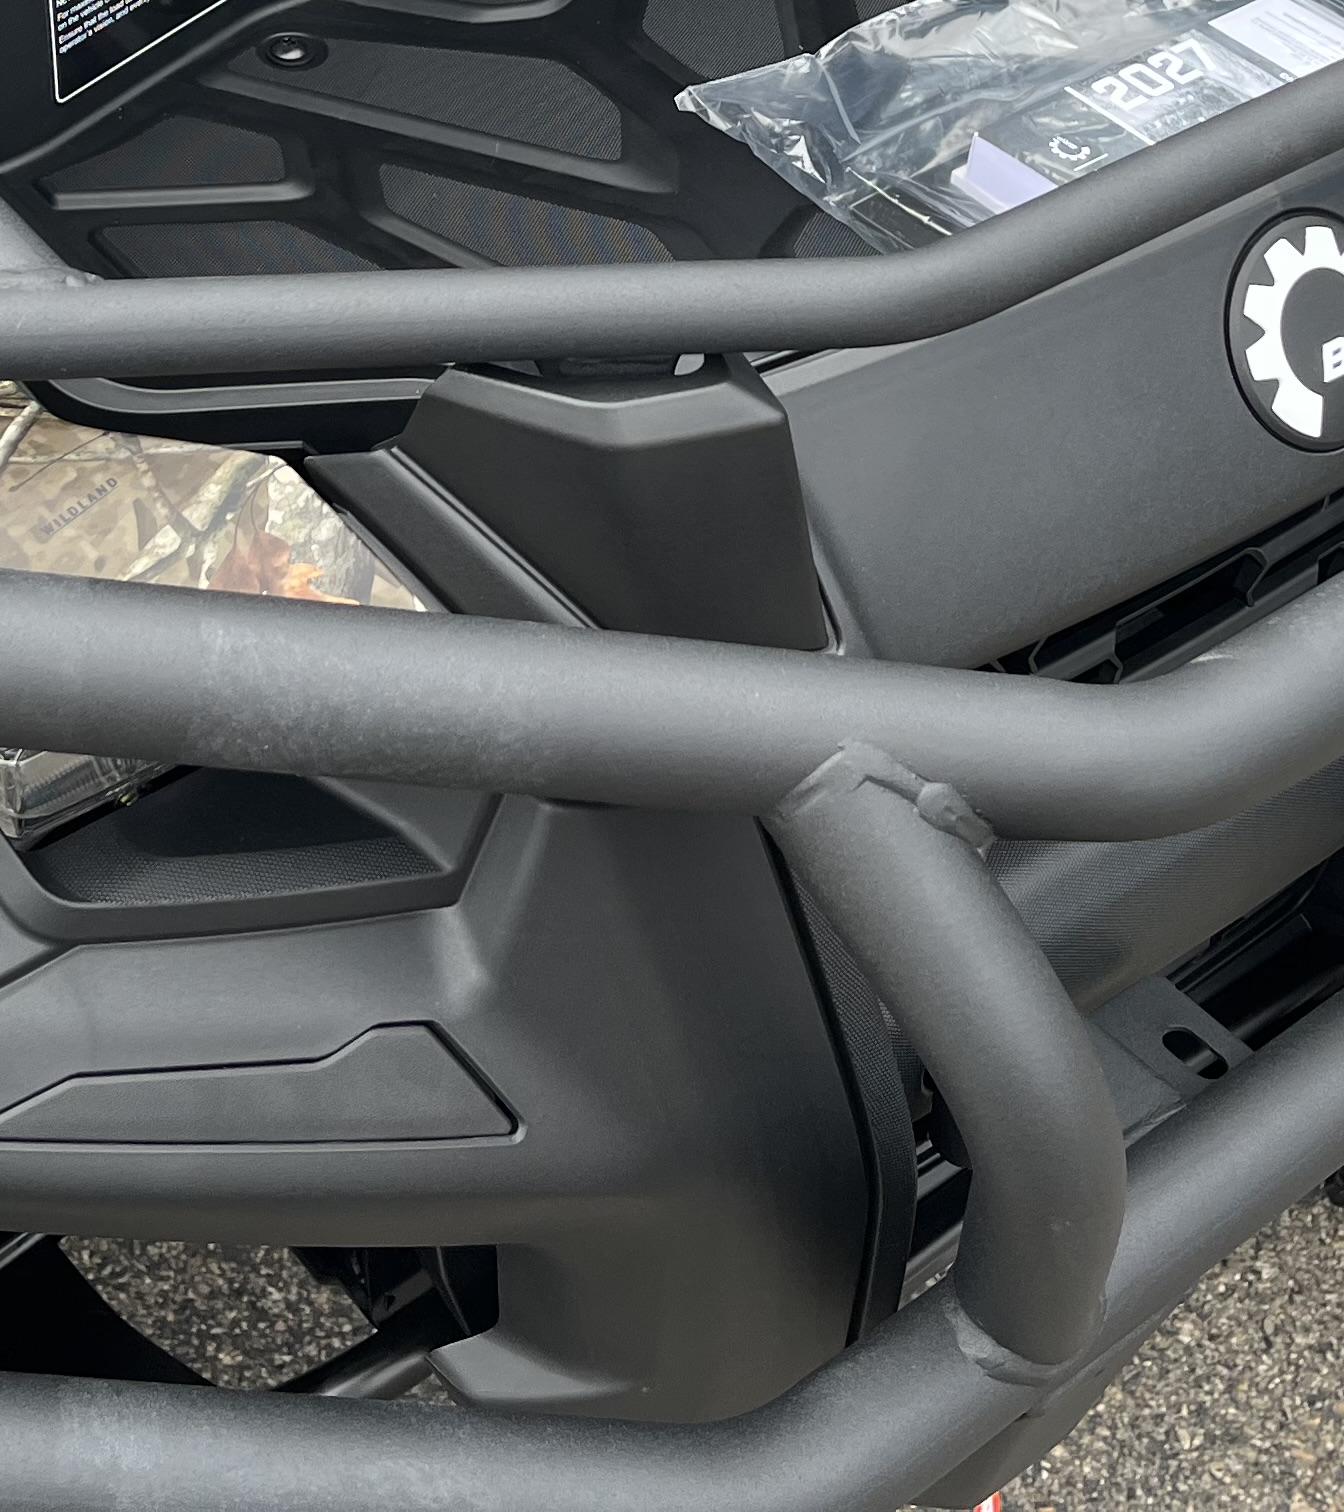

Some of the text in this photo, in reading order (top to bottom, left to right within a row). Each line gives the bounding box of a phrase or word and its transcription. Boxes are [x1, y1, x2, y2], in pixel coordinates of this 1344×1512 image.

[56, 7, 69, 22] For
[57, 20, 67, 32] on
[67, 12, 79, 26] the
[58, 23, 82, 45] Ensure
[83, 14, 96, 29] that
[97, 7, 108, 21] the
[59, 27, 92, 56] operator's
[115, 5, 128, 20] and
[1091, 38, 1216, 113] 2027
[40, 477, 118, 536] WILDLAND
